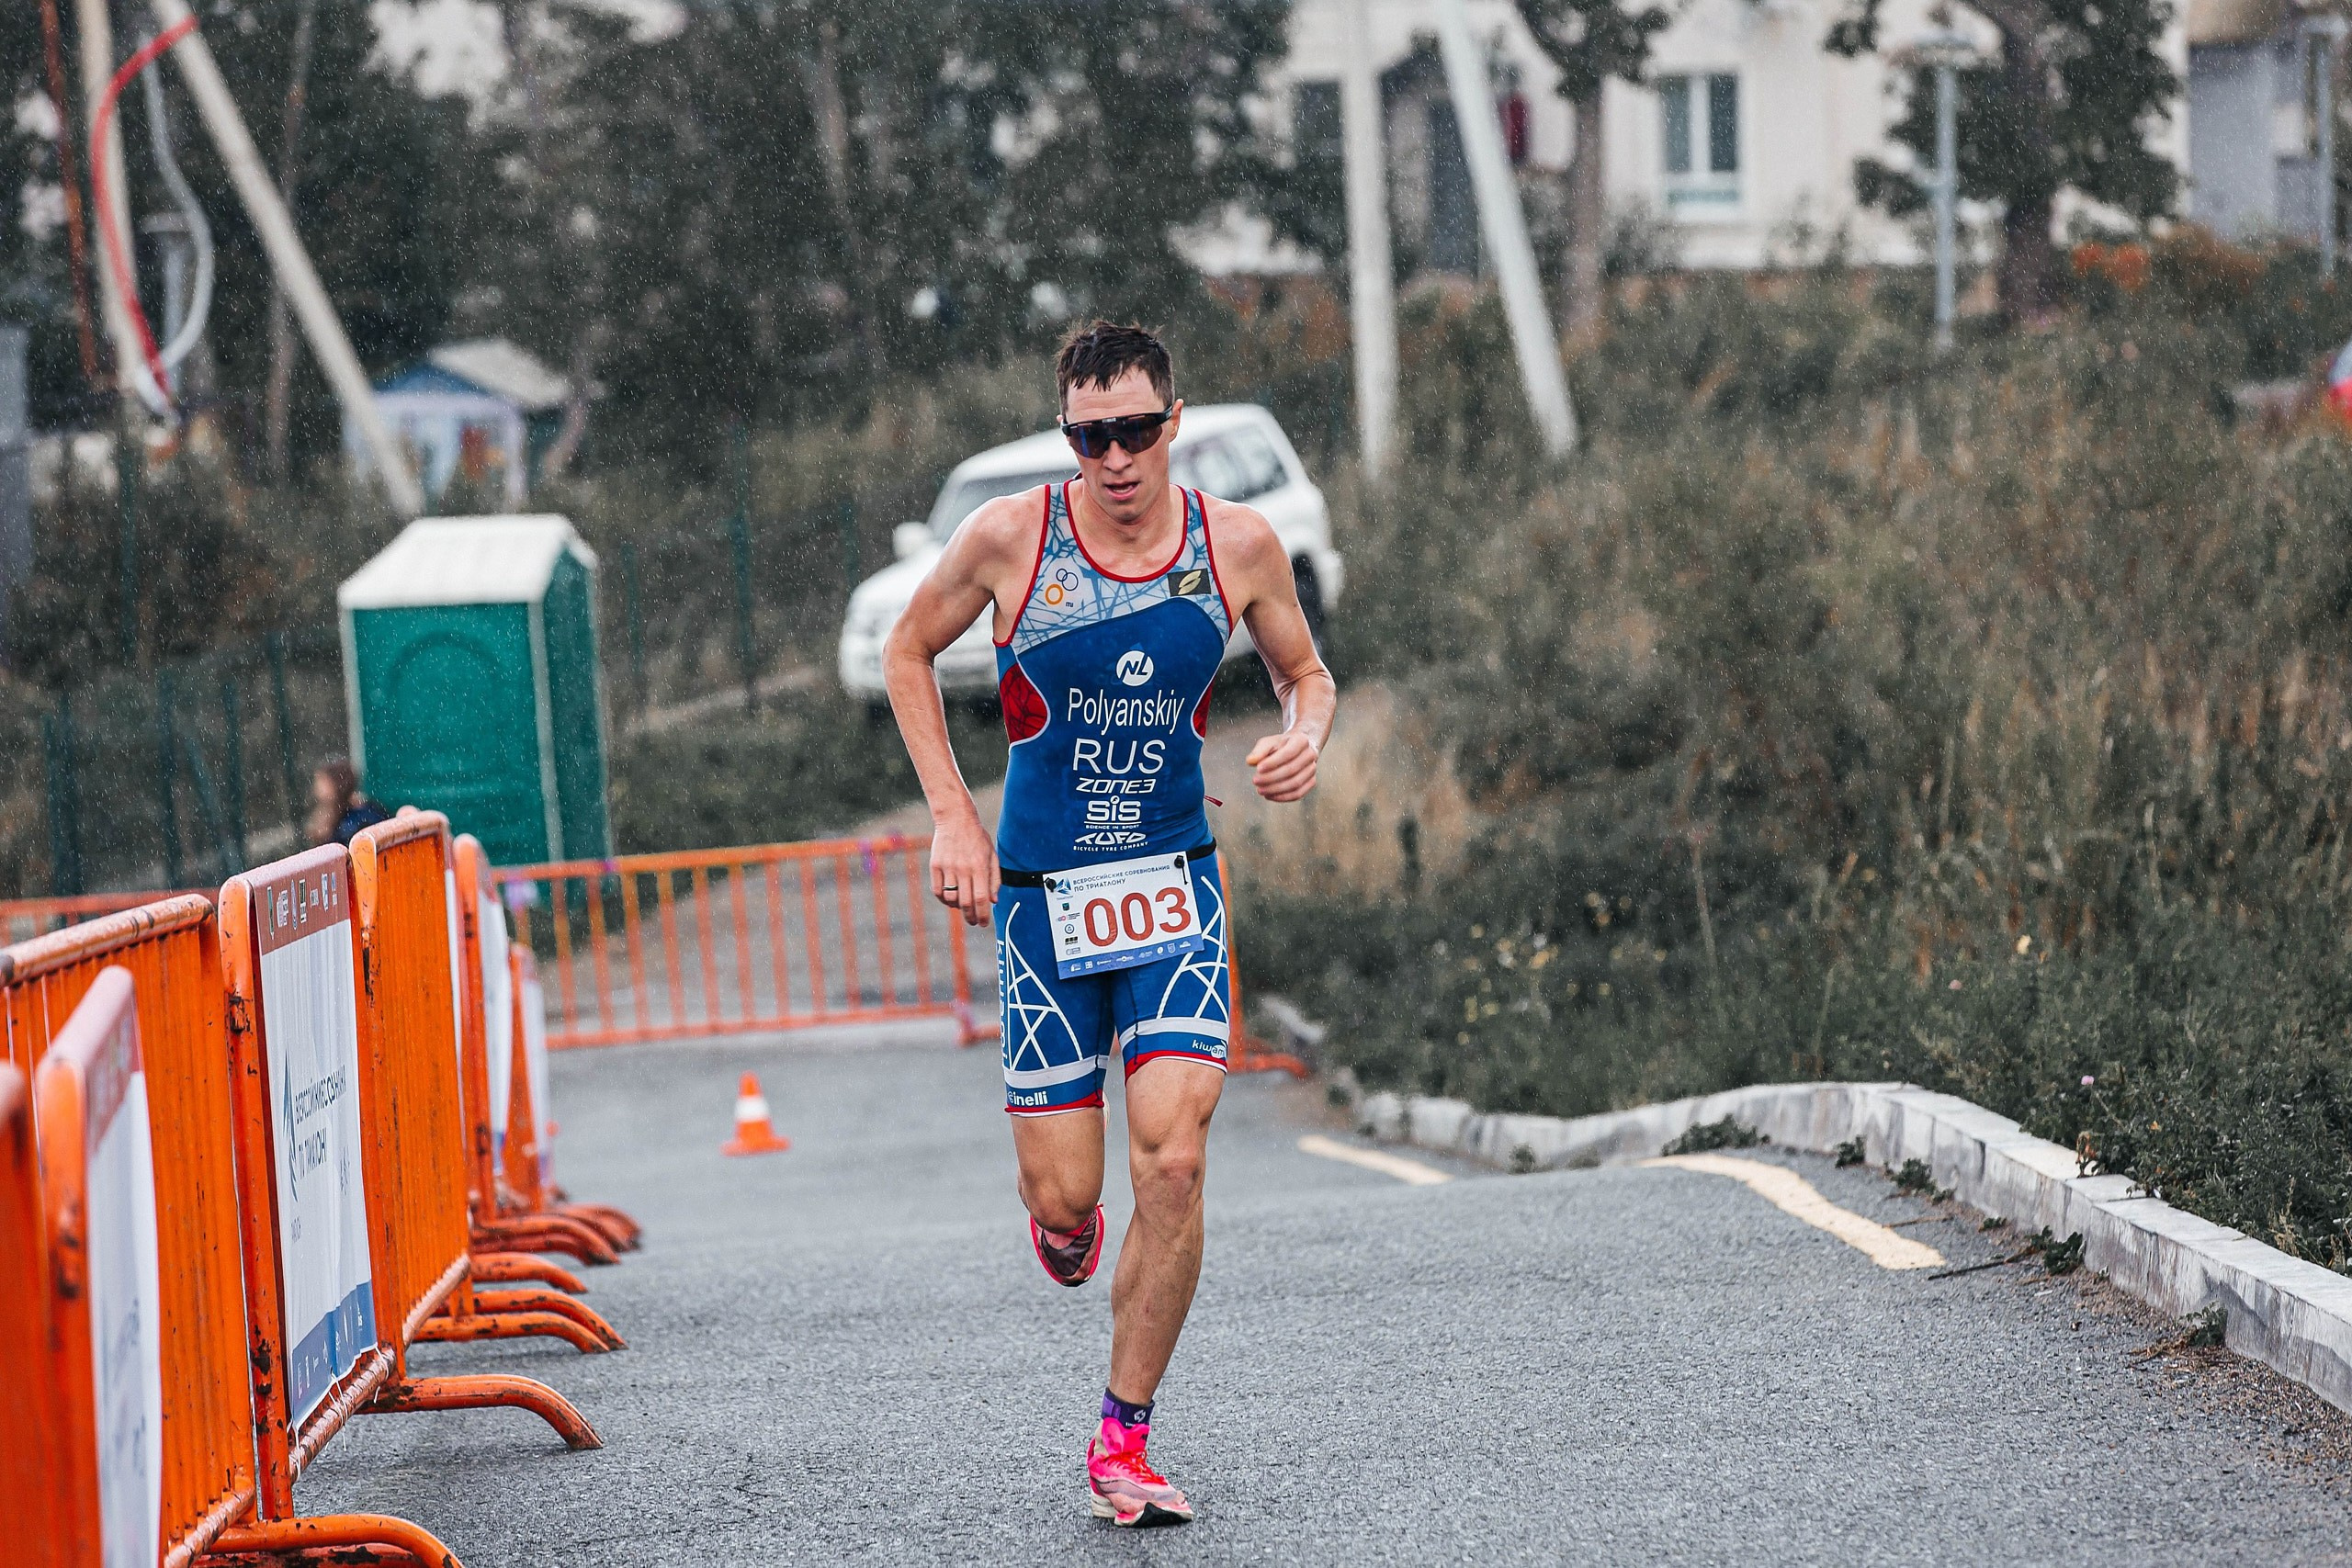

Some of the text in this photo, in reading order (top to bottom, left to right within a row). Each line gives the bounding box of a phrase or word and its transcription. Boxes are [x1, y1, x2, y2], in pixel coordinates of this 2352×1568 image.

[1118, 653, 1150, 682] NL
[1068, 687, 1185, 736] Polyanskiy
[1072, 738, 1166, 774] RUS
[1074, 831, 1147, 845] TUFO
[1120, 841, 1148, 852] COMPANY
[1073, 864, 1170, 886] ВСЕРОССИЙСКИЕ СОРЕВНОВАНИЯ
[1086, 878, 1126, 891] ТРИАТЛОНУ
[1083, 886, 1192, 947] 003
[1192, 1039, 1226, 1057] kiwam
